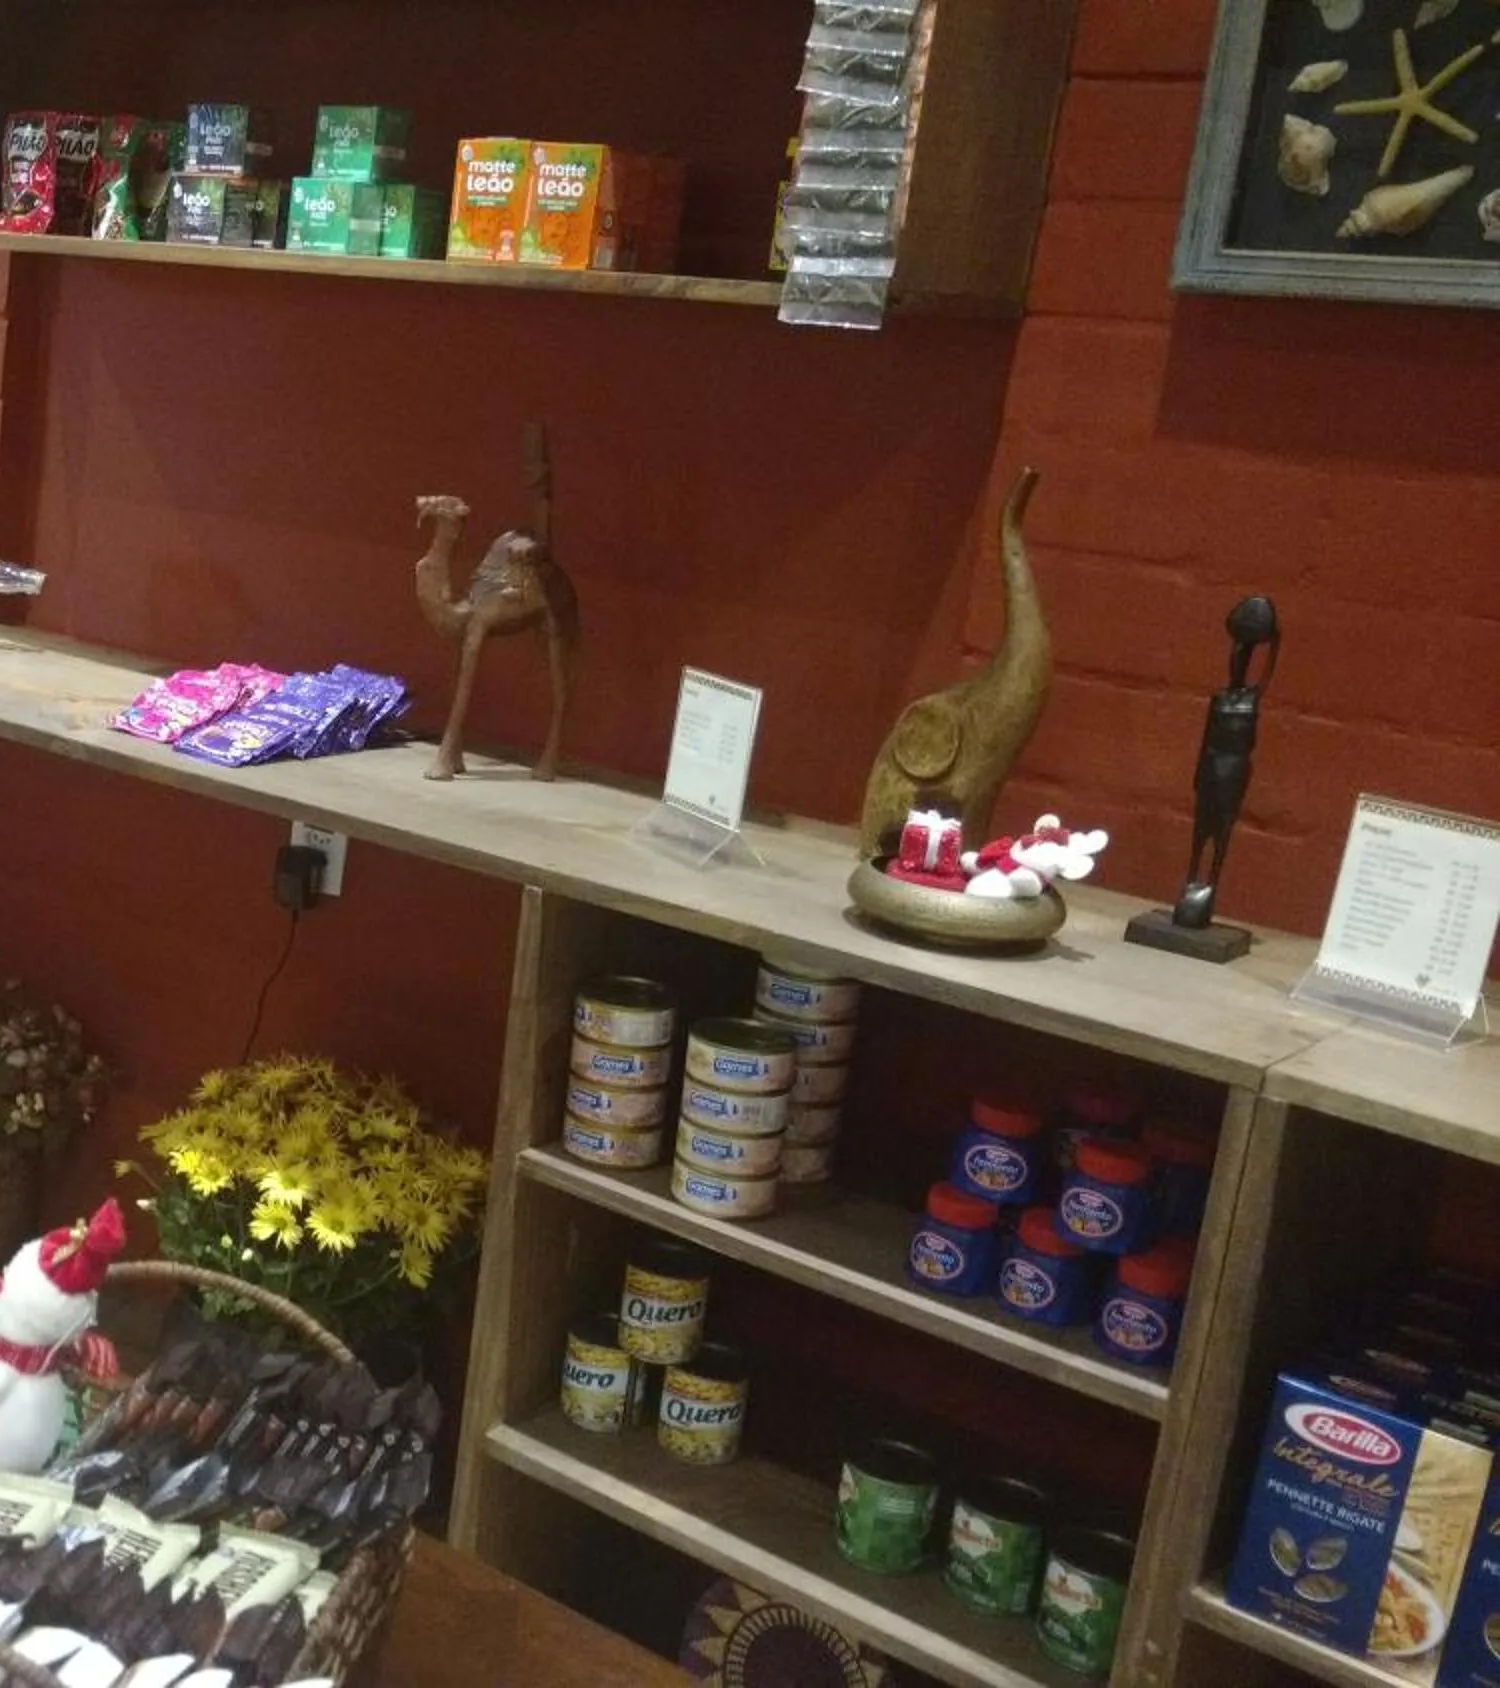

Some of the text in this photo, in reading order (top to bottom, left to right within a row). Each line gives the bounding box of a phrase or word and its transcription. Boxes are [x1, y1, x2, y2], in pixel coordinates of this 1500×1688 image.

[468, 160, 516, 173] matte
[539, 163, 587, 178] matte
[627, 1299, 702, 1324] Quero
[564, 1363, 616, 1389] uero
[666, 1399, 741, 1425] Quero
[1309, 1415, 1392, 1458] Barilla
[1266, 1477, 1334, 1515] PENNETTE
[1336, 1507, 1386, 1534] RIGATE
